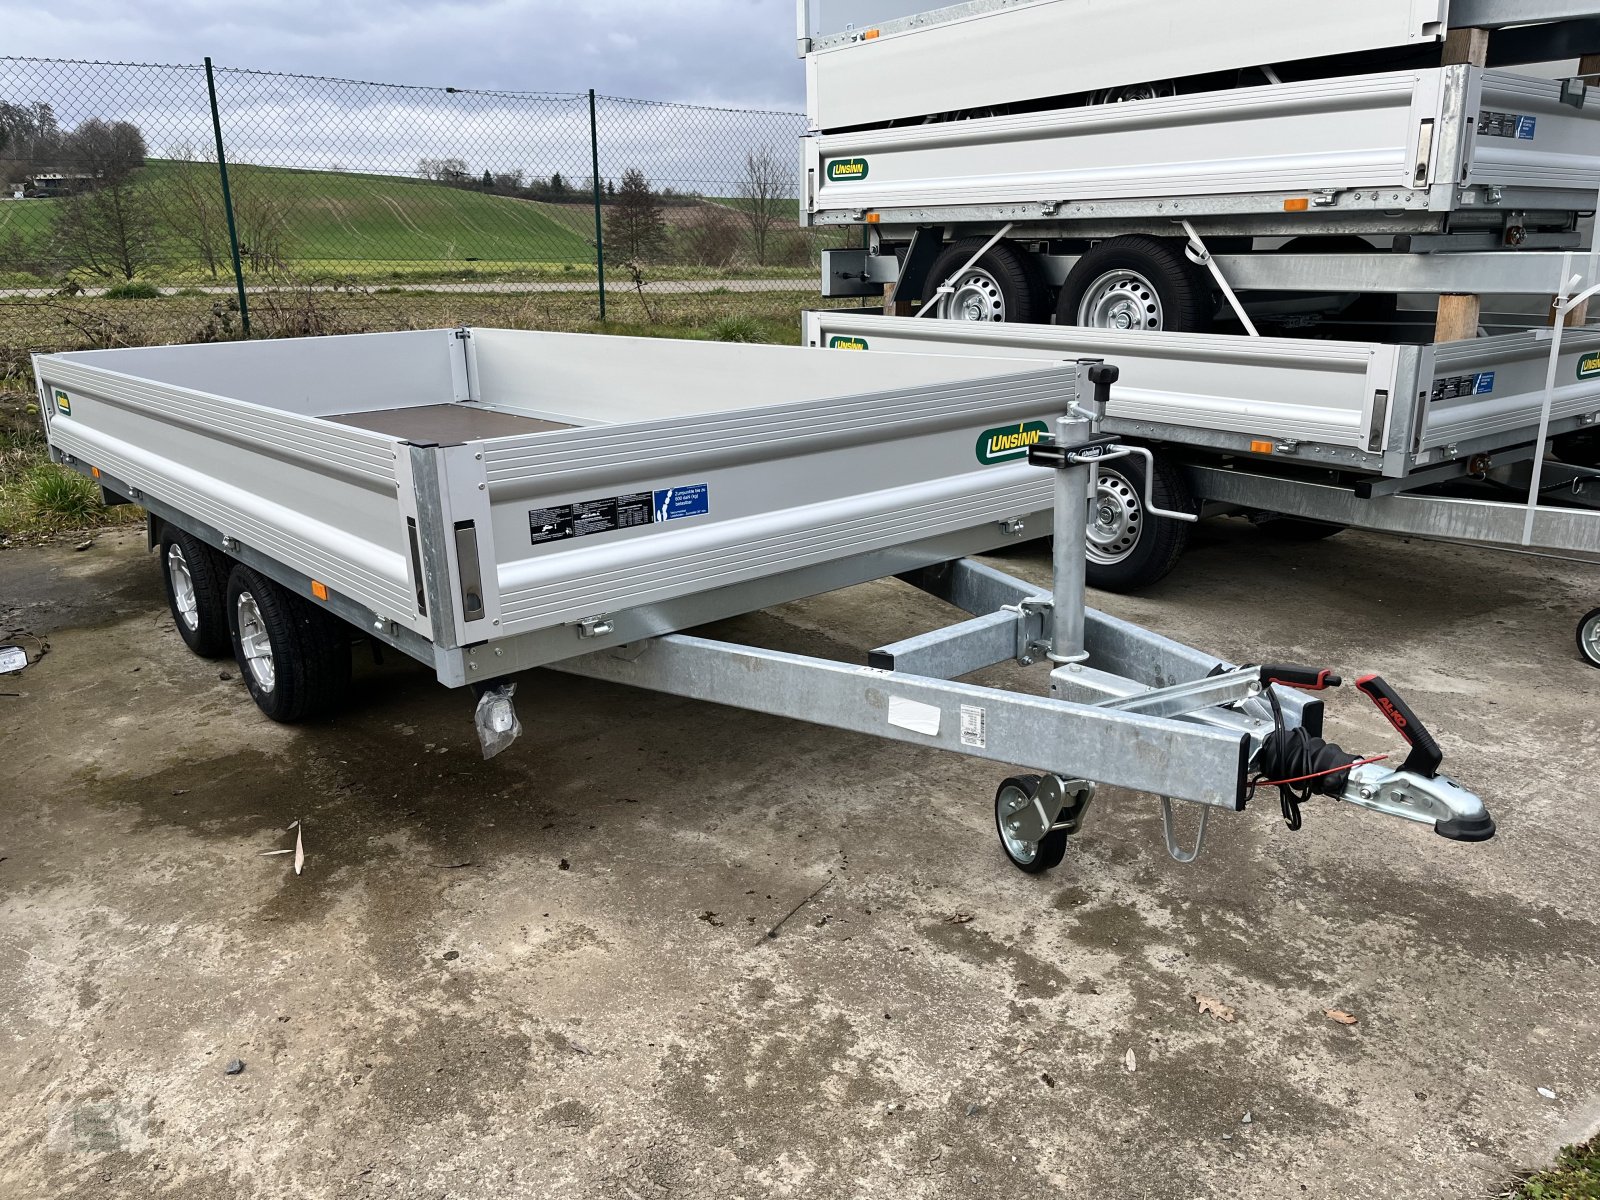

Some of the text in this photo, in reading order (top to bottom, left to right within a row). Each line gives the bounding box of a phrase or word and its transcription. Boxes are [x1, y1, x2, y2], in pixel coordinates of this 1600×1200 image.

[836, 159, 863, 174] UNSINN
[1584, 352, 1600, 370] UNSI
[991, 422, 1040, 452] UNSINN
[1378, 698, 1407, 727] AL-KO
